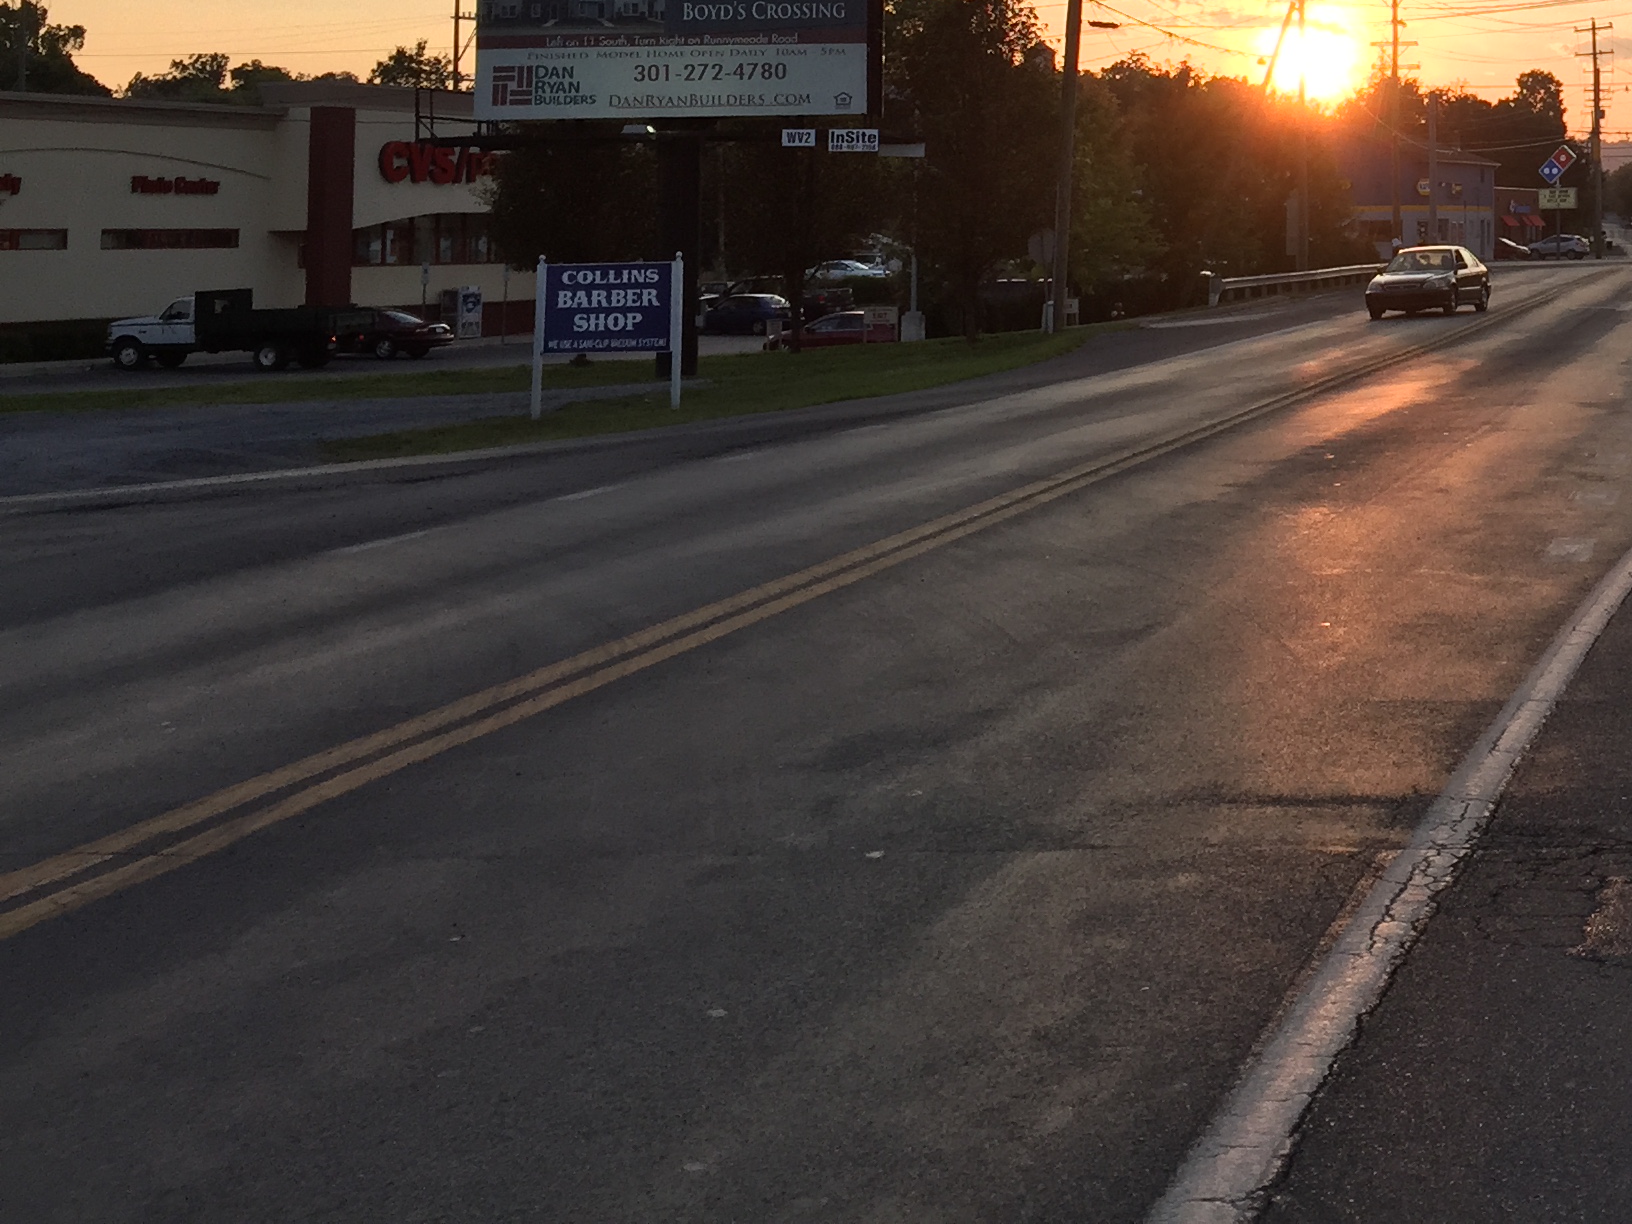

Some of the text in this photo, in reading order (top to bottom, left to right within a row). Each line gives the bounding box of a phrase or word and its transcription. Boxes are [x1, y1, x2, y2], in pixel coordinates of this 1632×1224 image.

[682, 1, 846, 21] BOYD'S CROSSING
[633, 35, 656, 46] Turn
[687, 38, 701, 46] on
[771, 33, 798, 45] Road
[534, 65, 574, 80] DAN
[633, 62, 787, 83] 301-272-4780
[534, 81, 580, 94] RYAN
[534, 94, 597, 106] BUILDERS
[786, 131, 811, 144] WV2
[830, 131, 877, 144] InSite
[561, 269, 660, 285] COLLINS
[556, 288, 661, 308] BARBER
[573, 312, 643, 332] SHOP
